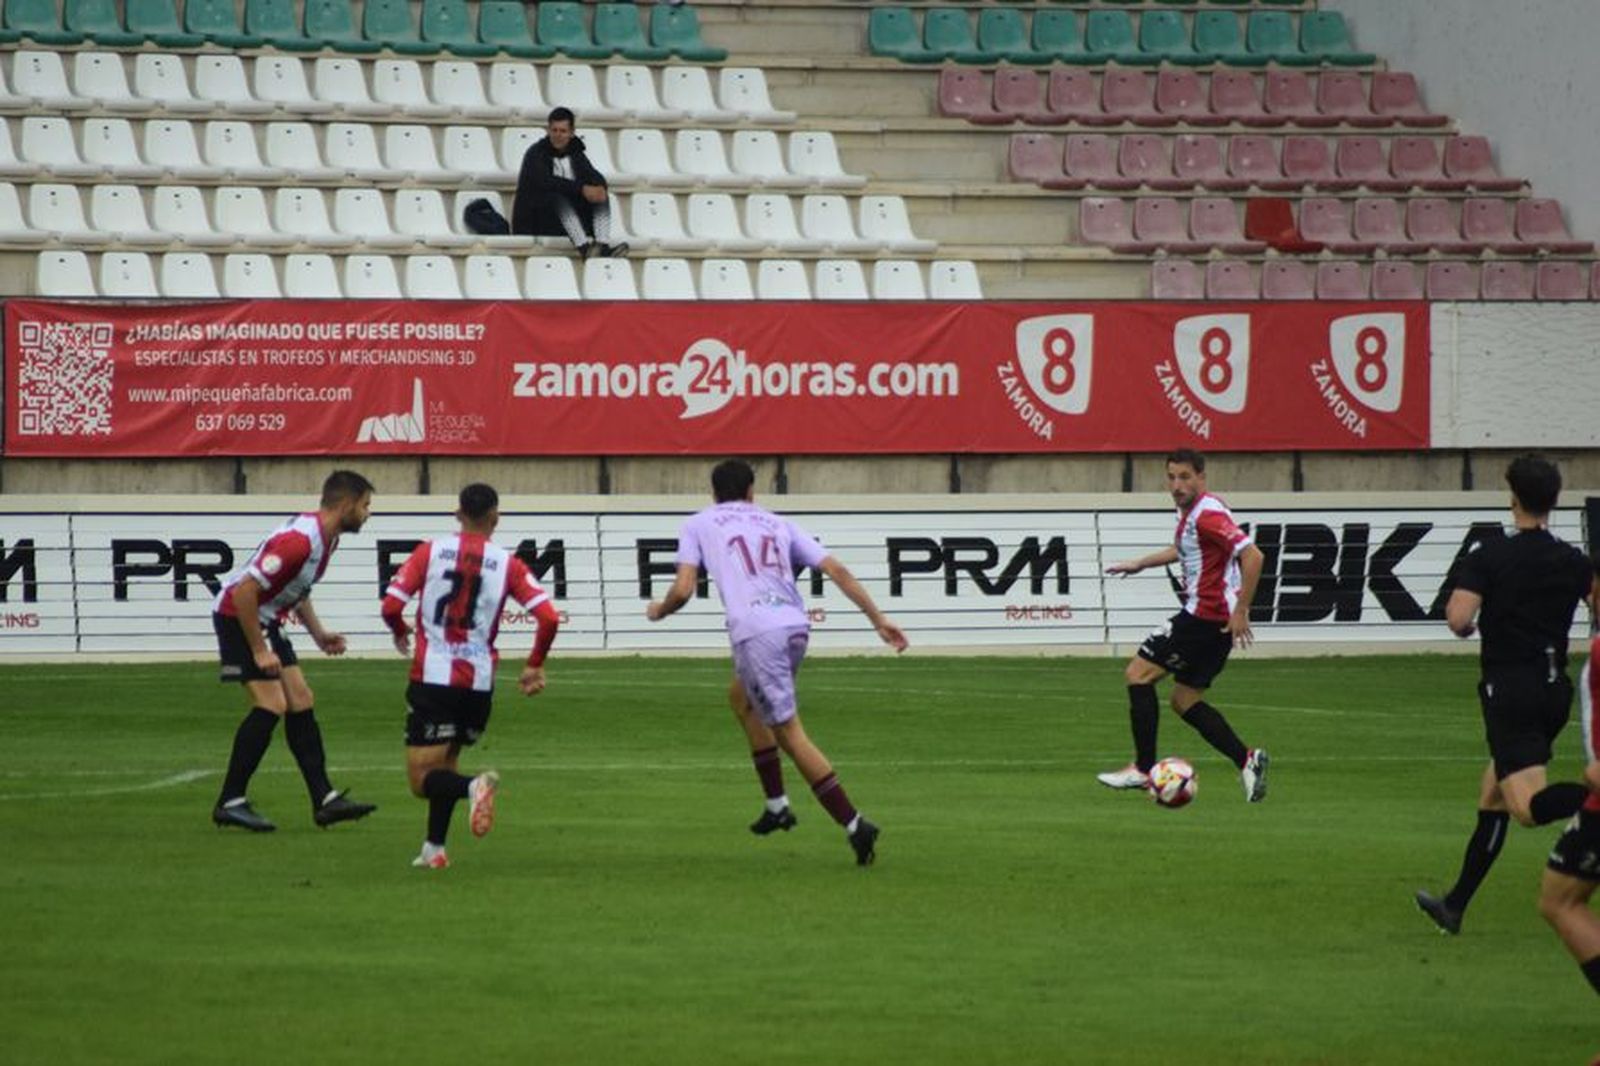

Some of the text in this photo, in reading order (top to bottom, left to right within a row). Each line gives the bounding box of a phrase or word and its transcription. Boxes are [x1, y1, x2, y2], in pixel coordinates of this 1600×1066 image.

[125, 320, 486, 344] ¿HABÍAS IMAGINADO QUE FUESE POSIBLE?
[135, 350, 475, 366] ESPECIALISTAS EN TROFEOS Y MERCHANDISING 3D
[1042, 328, 1075, 395] 8
[1199, 327, 1232, 394] 8
[1355, 326, 1388, 393] 8
[128, 382, 353, 405] www.mipequeñafabrica.com
[512, 350, 960, 397] zamora24horas.com
[996, 361, 1055, 441] ZAMORA
[1154, 360, 1211, 440] ZAMORA
[1310, 358, 1367, 438] ZAMORA
[195, 413, 286, 431] 637 069 529
[111, 538, 235, 601] PR
[727, 534, 784, 578] 14
[885, 535, 1070, 597] PRM
[433, 569, 484, 631] 21
[1005, 604, 1073, 620] RACING
